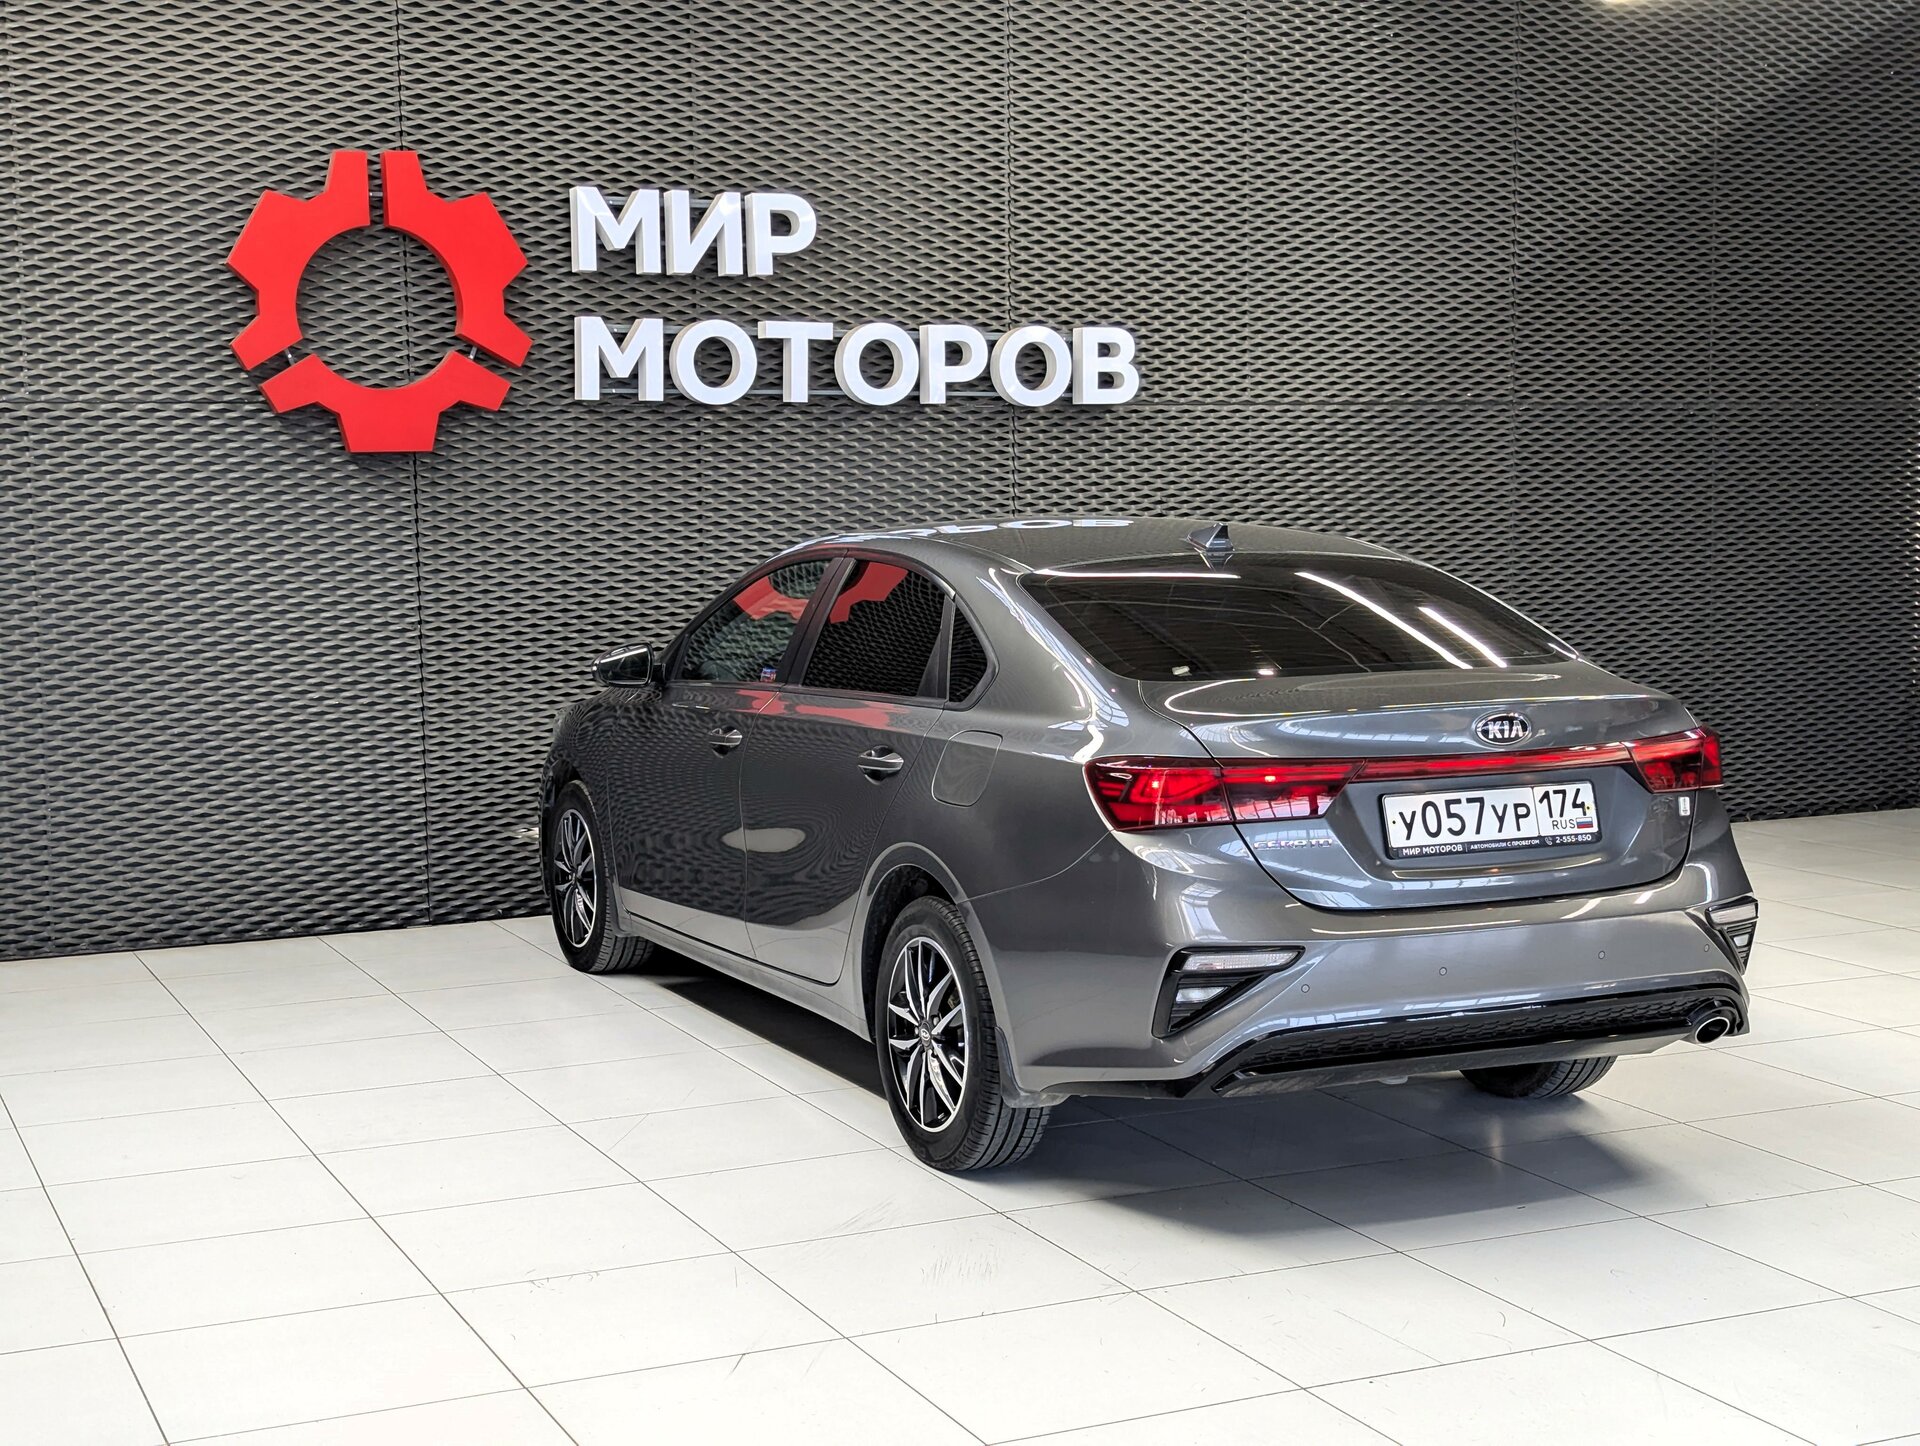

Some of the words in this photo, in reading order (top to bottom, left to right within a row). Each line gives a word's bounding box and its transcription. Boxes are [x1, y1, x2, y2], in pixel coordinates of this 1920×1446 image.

[569, 186, 817, 276] МИР
[574, 316, 1140, 407] МОТОРОВ
[1488, 720, 1524, 739] KIA
[1538, 788, 1587, 819] 174
[1552, 819, 1576, 831] RUS
[1555, 833, 1592, 844] 2-555-850
[1402, 846, 1421, 857] МИР
[1422, 843, 1463, 855] МОТОРОВ
